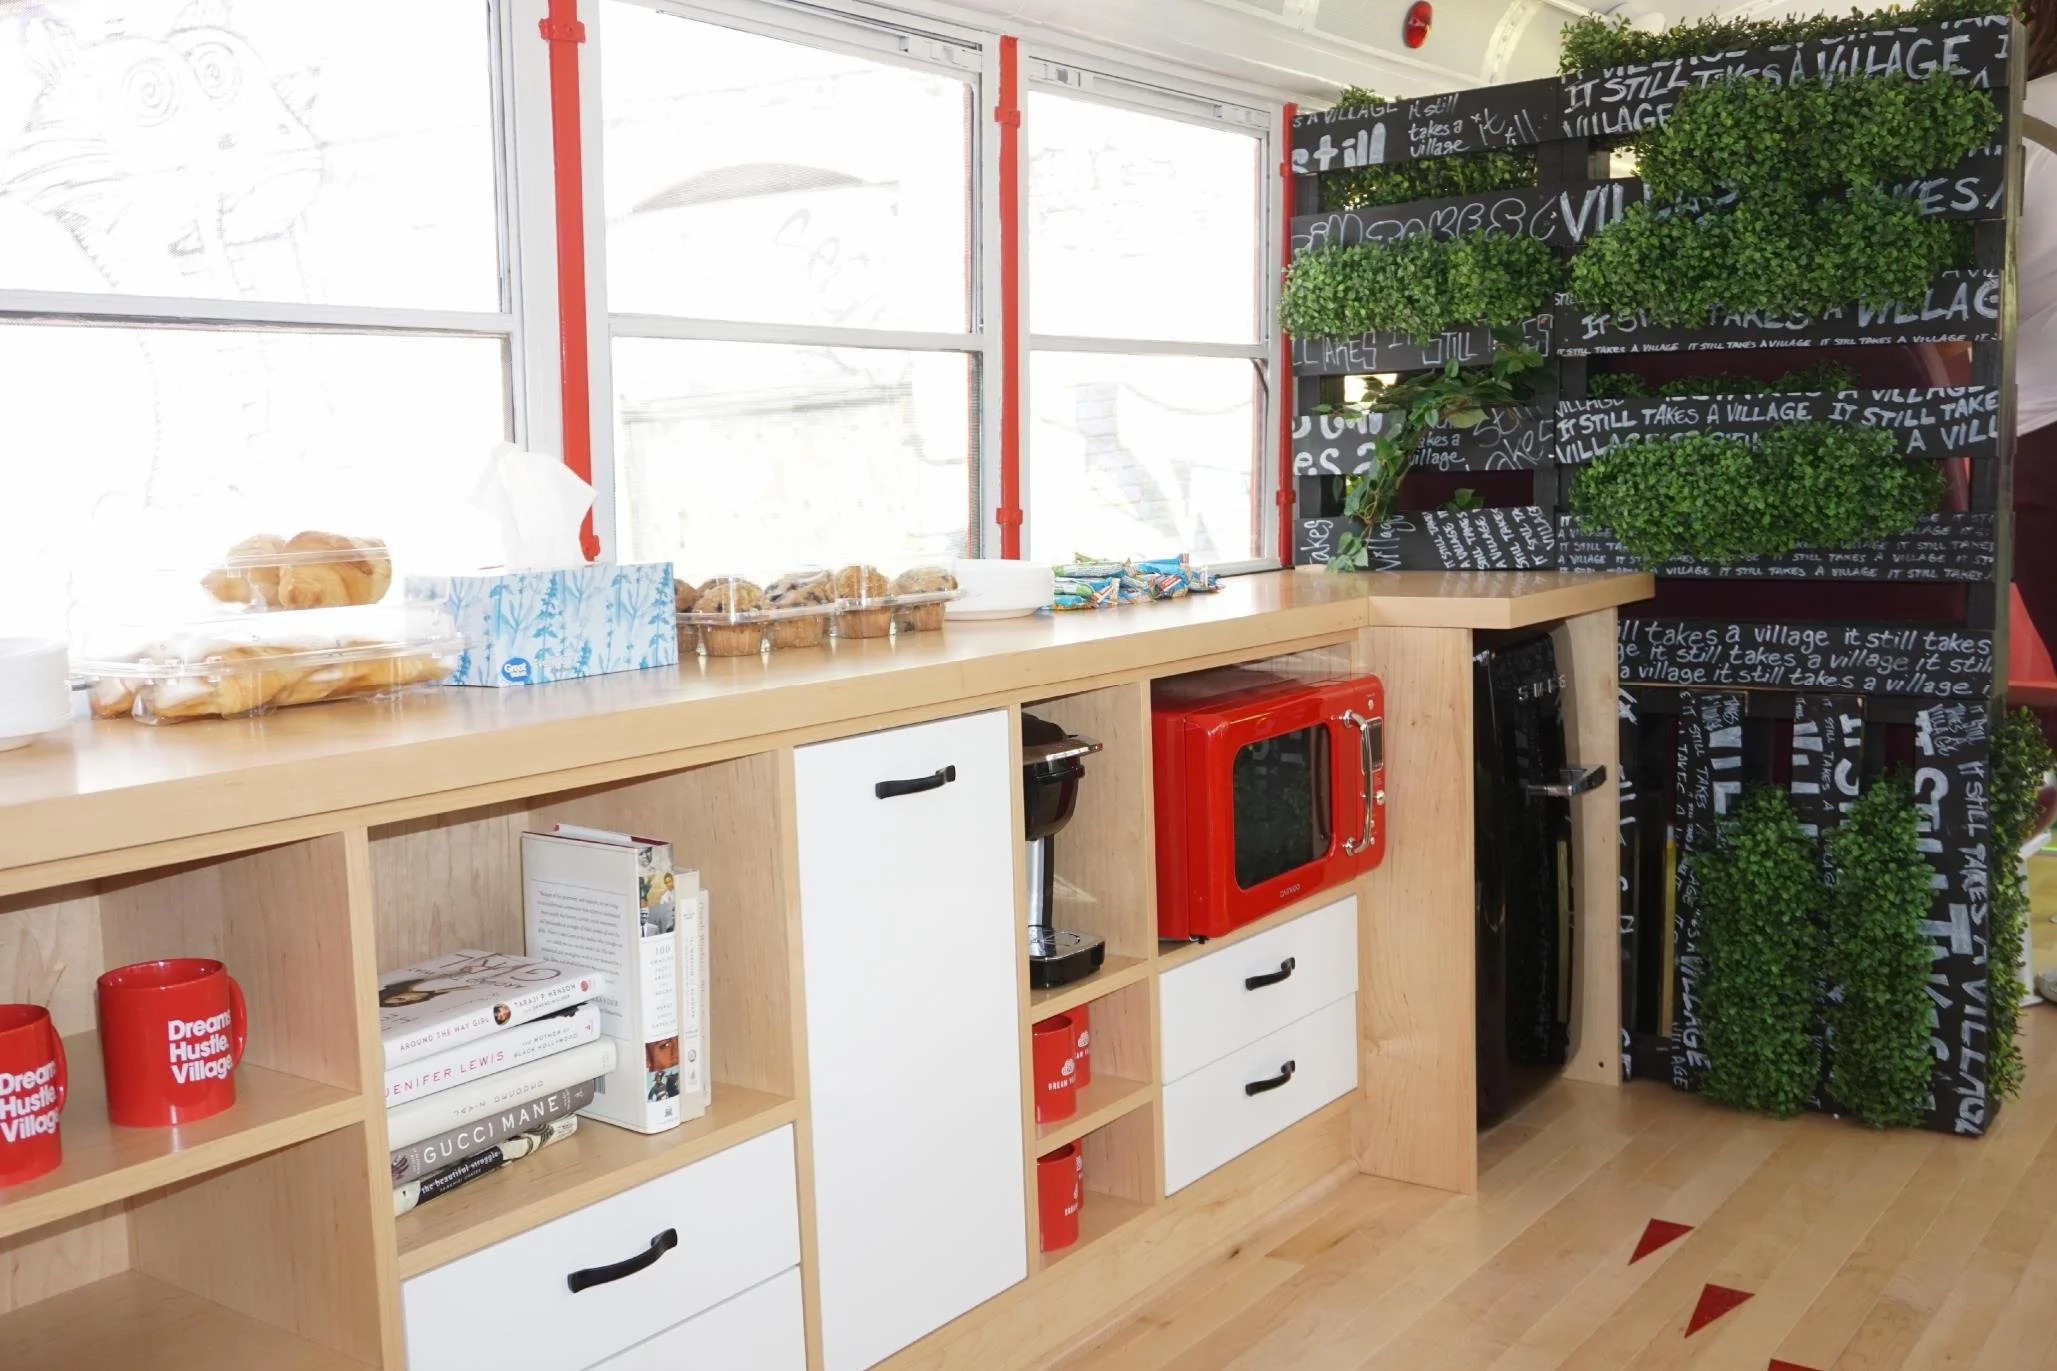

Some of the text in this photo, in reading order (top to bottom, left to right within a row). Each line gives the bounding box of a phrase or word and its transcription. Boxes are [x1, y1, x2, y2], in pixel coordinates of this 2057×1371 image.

[1564, 78, 1599, 113] IT
[1600, 64, 1689, 102] STILL
[1408, 120, 1464, 143] takes a
[1410, 138, 1471, 158] village
[1630, 343, 1640, 353] A
[1642, 342, 1680, 352] VILLAGE
[1698, 340, 1725, 350] STILL
[1726, 339, 1757, 349] TAKES
[1768, 337, 1812, 348] VILLAGE
[1896, 335, 1909, 344] A
[1912, 333, 1968, 343] VILLAGE
[1556, 418, 1577, 442] IT
[1578, 409, 1638, 435] STILL
[1641, 403, 1700, 426] TAKES
[1706, 403, 1720, 425] A
[1726, 401, 1813, 422] VILLAGE
[1828, 401, 1858, 422] IT
[1860, 406, 1937, 428] STILL
[1906, 428, 1927, 454] A
[1475, 515, 1503, 560] VILLAGE
[1569, 554, 1607, 565] VILLAGE
[1792, 553, 1822, 562] STILL
[1828, 553, 1867, 563] TAKES
[1873, 553, 1884, 562] A
[1892, 553, 1947, 563] VILLAGE
[1666, 565, 1983, 581] VILLAGE IT STILL TAKES A VILLAGE IT STILL TAKES
[1644, 620, 1719, 648] takes
[1725, 624, 1741, 643] a
[1754, 624, 1830, 655] village
[1844, 627, 1862, 646] it
[1865, 629, 1918, 650] still
[1922, 631, 1992, 656] takes
[1650, 643, 1668, 661] it
[1676, 644, 1723, 664] still
[1730, 644, 1797, 668] takes
[1807, 653, 1822, 669] a
[1830, 649, 1909, 675] village
[1915, 652, 1941, 671] it
[1619, 661, 1973, 697] a village it still takes a village
[1694, 765, 1710, 809] TAKES
[1821, 751, 1835, 792] TAKES
[1822, 800, 1835, 812] A
[1963, 780, 1989, 838] STILL
[548, 983, 576, 998] HENSON
[400, 1016, 489, 1052] AROUND THE WAY GIRL
[384, 1050, 506, 1098] JENIFER LEWIS
[423, 1121, 495, 1164] GUCCI
[502, 1095, 560, 1133] MANE
[421, 1182, 435, 1195] the
[435, 1164, 470, 1188] beautiful
